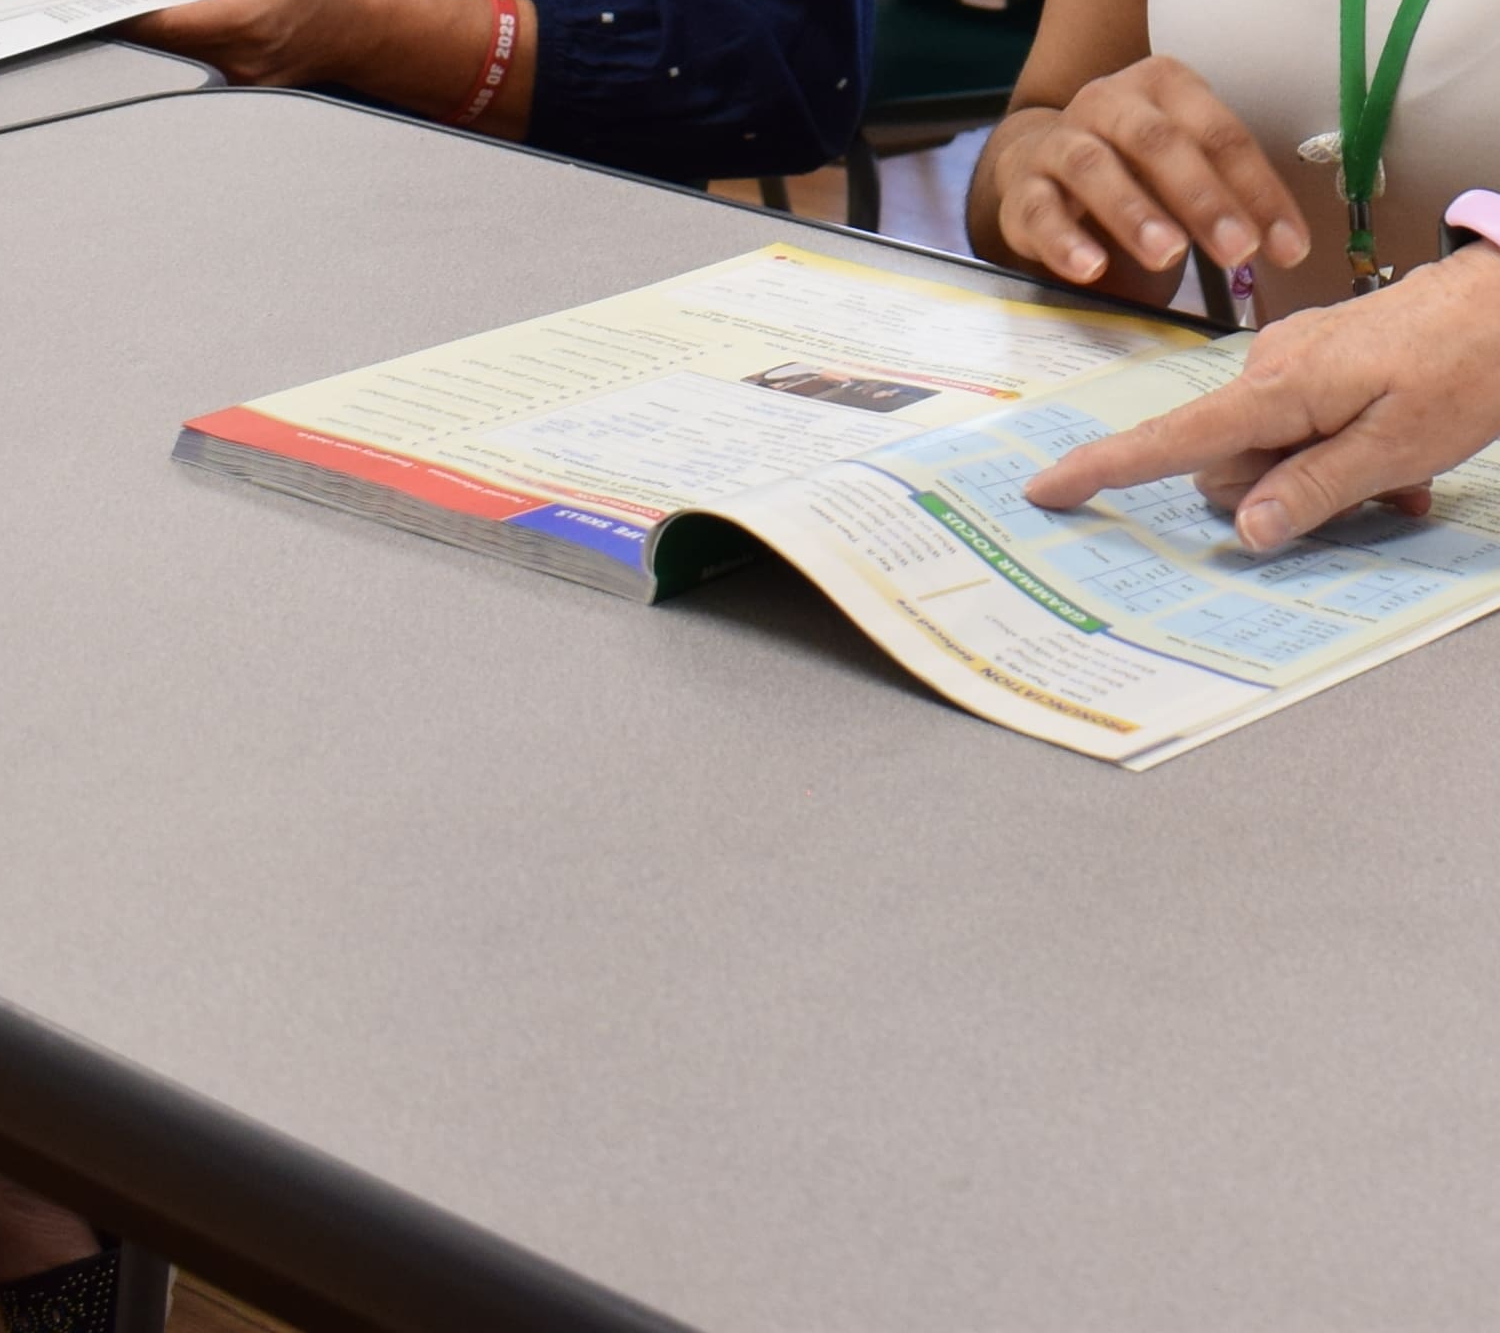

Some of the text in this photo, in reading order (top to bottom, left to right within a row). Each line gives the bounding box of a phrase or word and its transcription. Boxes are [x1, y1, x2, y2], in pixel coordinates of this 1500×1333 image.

[941, 511, 1088, 623] GRAMMAR FOCUS
[980, 667, 1130, 735] PRONUNCIATION
